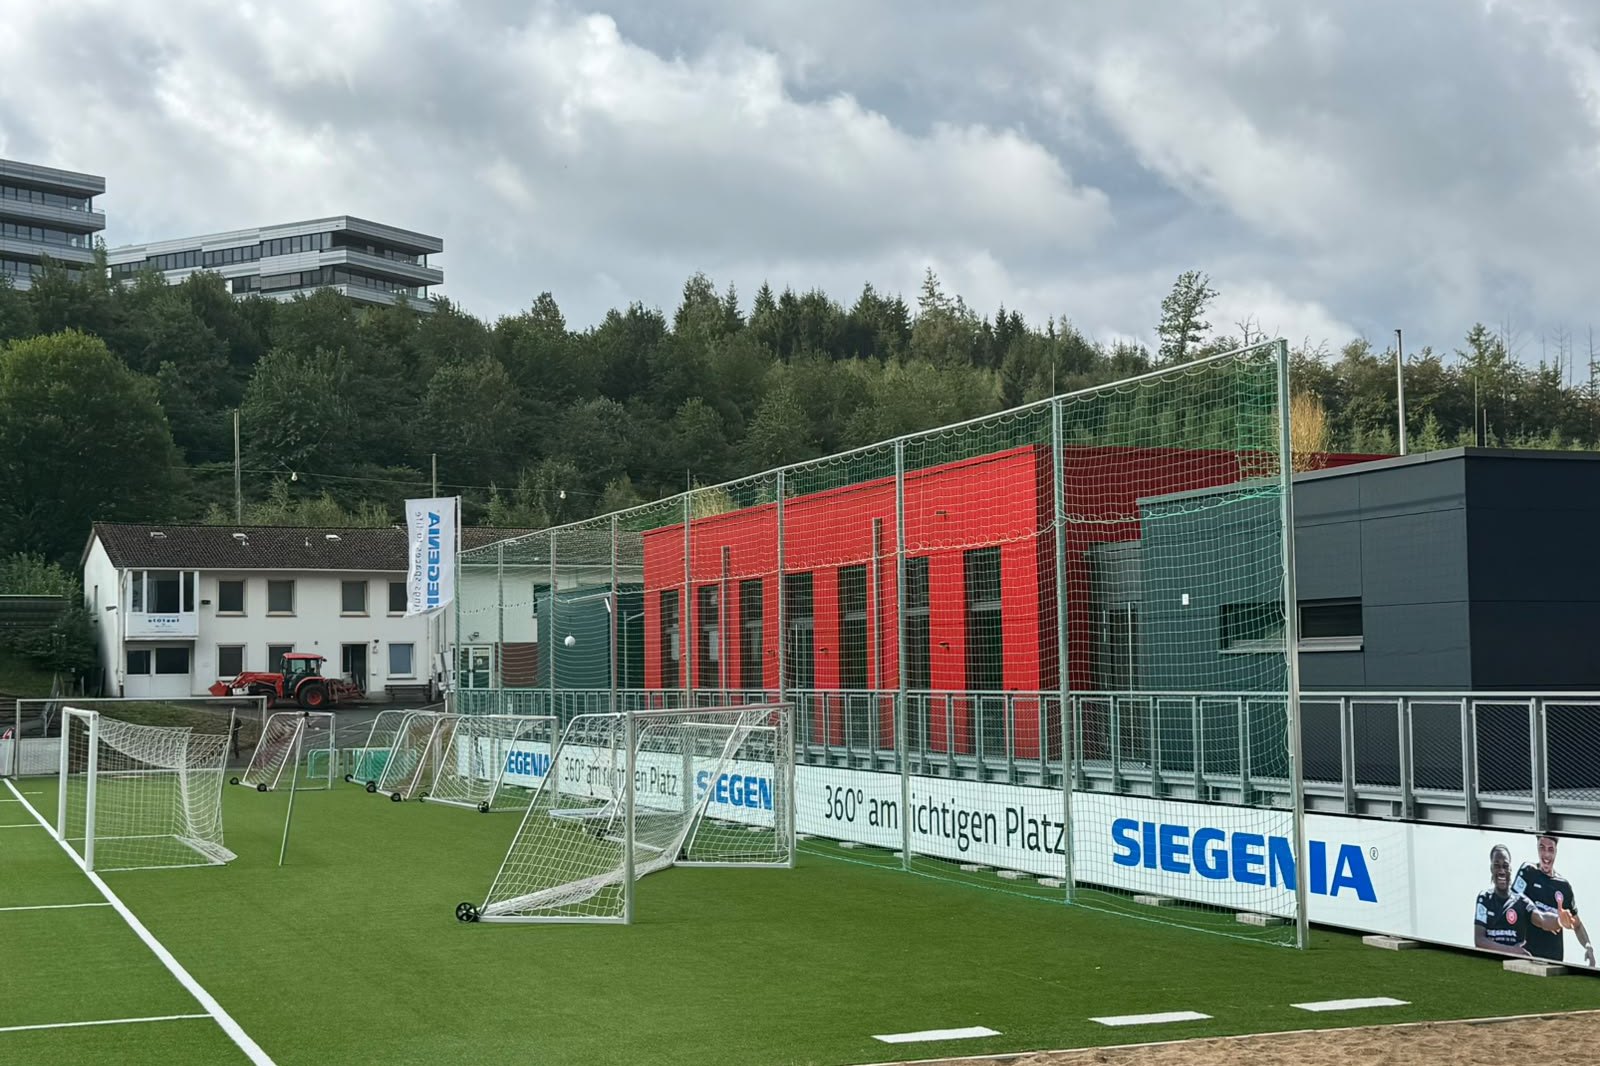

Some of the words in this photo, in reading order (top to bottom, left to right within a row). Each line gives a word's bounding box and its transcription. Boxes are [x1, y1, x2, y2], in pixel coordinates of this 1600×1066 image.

[504, 749, 551, 777] IEGENIA
[650, 766, 678, 796] Platz
[696, 770, 772, 810] SIEGEN
[825, 785, 863, 822] 360°
[868, 798, 898, 829] am
[910, 793, 997, 851] ichtigen
[1006, 806, 1065, 855] Platz
